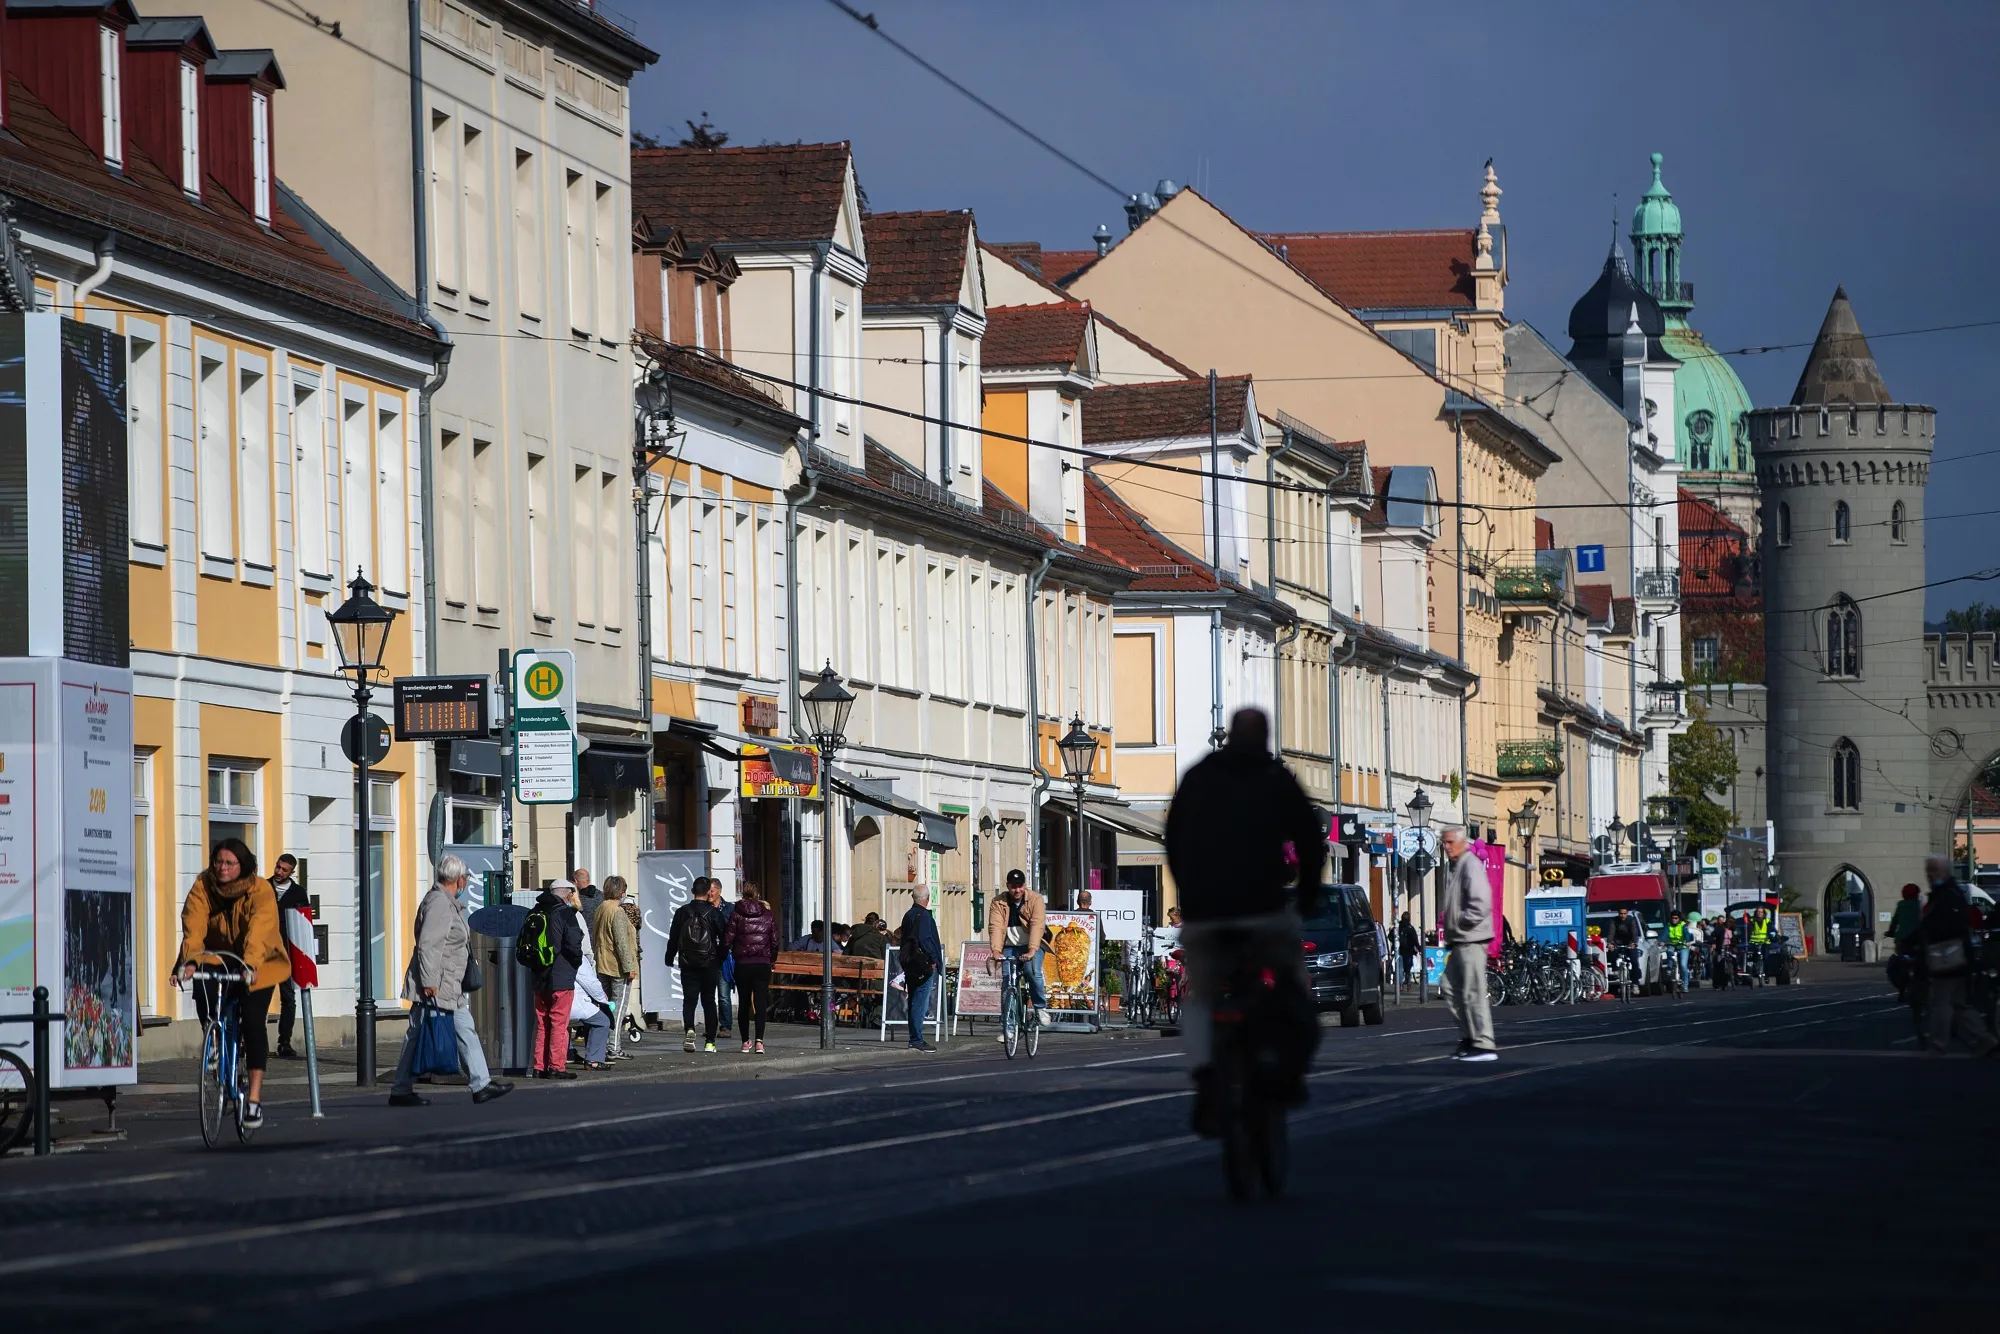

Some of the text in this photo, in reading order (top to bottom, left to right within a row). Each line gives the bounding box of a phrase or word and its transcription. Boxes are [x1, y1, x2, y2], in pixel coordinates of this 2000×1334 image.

[760, 784, 800, 796] ALI BABA
[1095, 909, 1136, 921] TRIO
